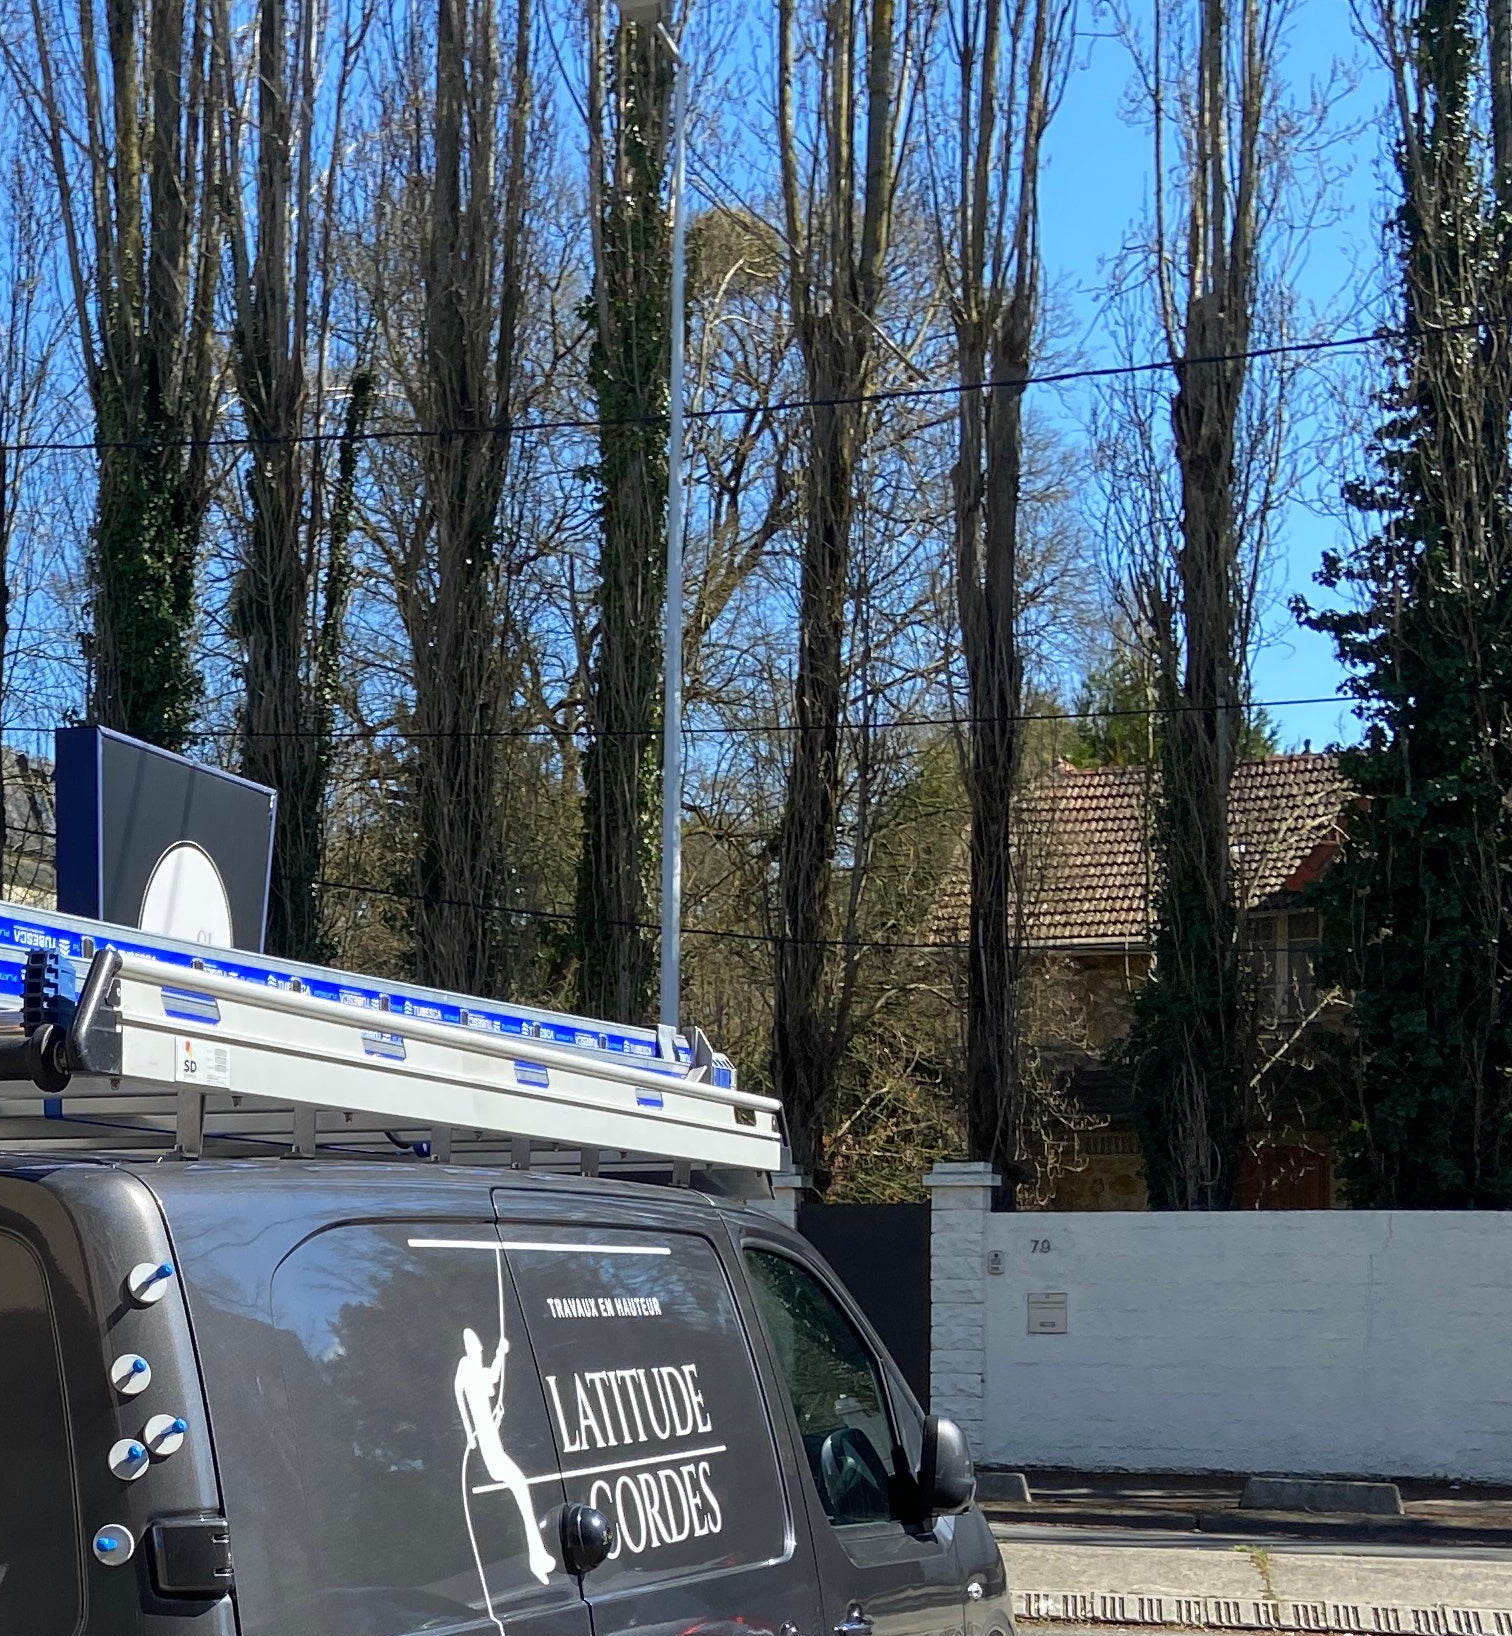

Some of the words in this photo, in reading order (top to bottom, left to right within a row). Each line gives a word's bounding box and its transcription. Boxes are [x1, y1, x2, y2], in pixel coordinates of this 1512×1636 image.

[1030, 1239, 1051, 1253] 79
[547, 1297, 599, 1318] TRAVAUX
[598, 1297, 615, 1317] EN
[614, 1297, 662, 1317] HAUTEUR
[546, 1363, 712, 1452] LATITUDE
